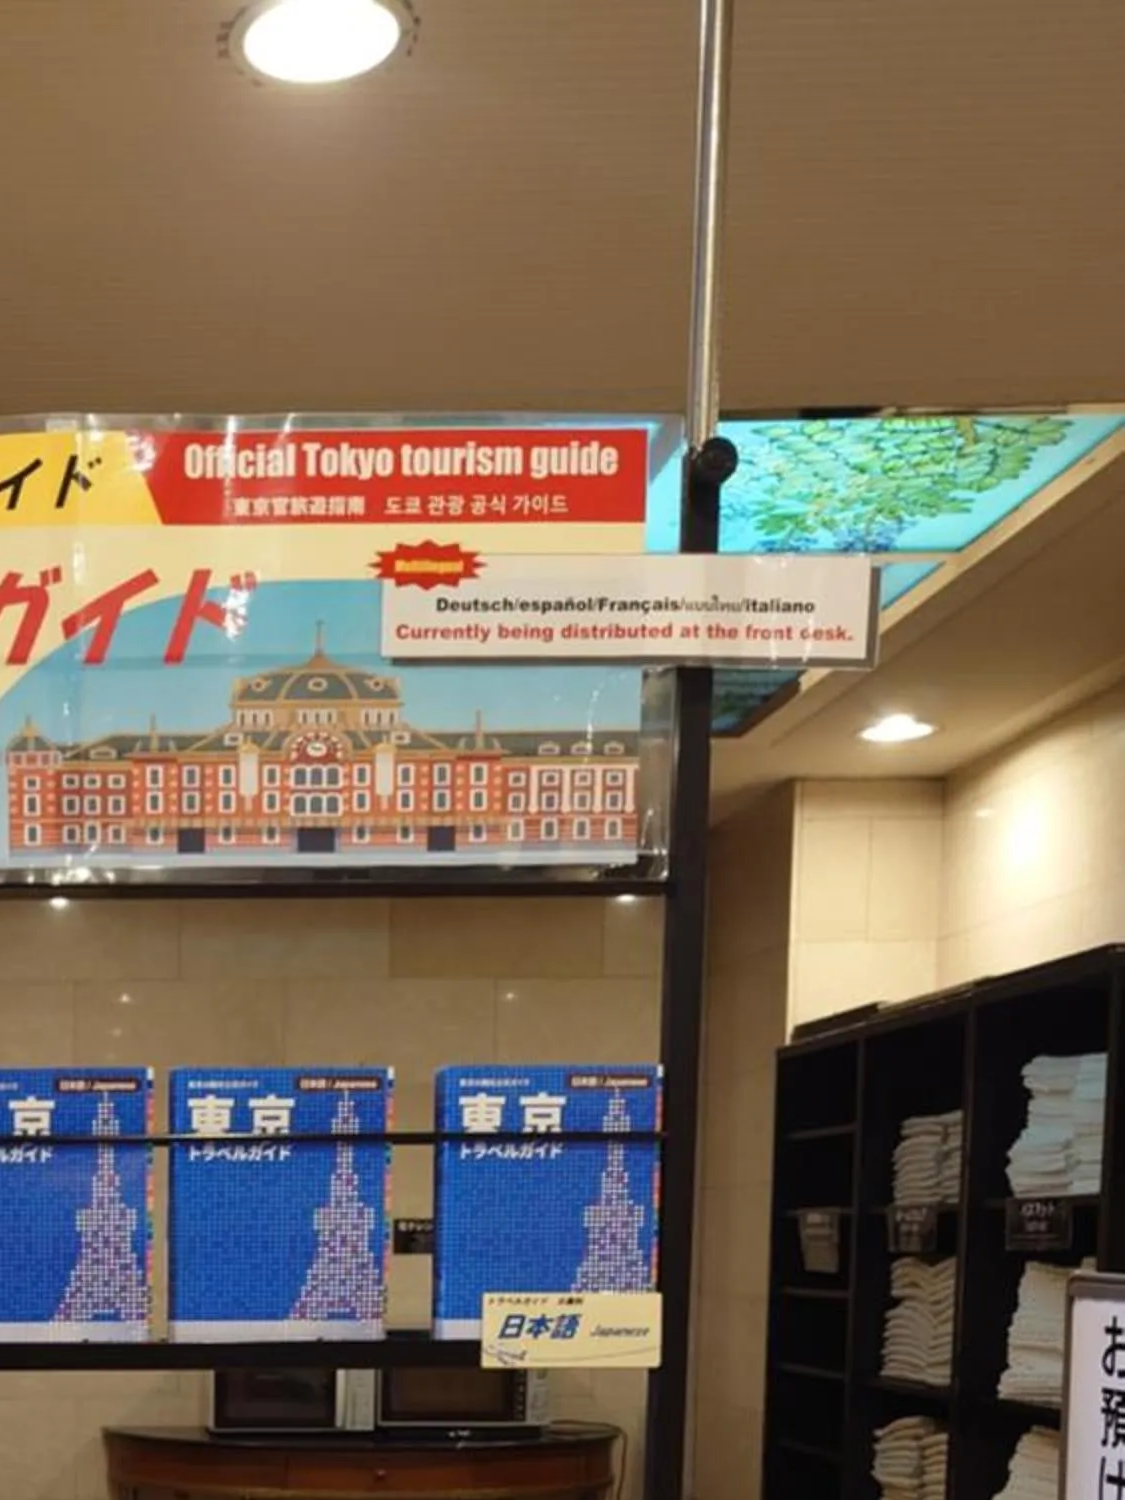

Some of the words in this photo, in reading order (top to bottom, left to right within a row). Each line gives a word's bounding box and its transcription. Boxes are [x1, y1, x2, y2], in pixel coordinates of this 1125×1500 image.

[184, 443, 296, 479] Official
[302, 445, 393, 481] Tokyo
[401, 443, 521, 477] tourism
[530, 442, 618, 479] guide
[513, 494, 569, 515] 가이드
[396, 624, 491, 643] Currently
[498, 624, 554, 642] being
[561, 623, 673, 639] distributed
[680, 625, 700, 639] at
[707, 624, 739, 639] the
[746, 624, 793, 640] front
[498, 1313, 582, 1340] 日本語
[590, 1324, 650, 1338] Japanese
